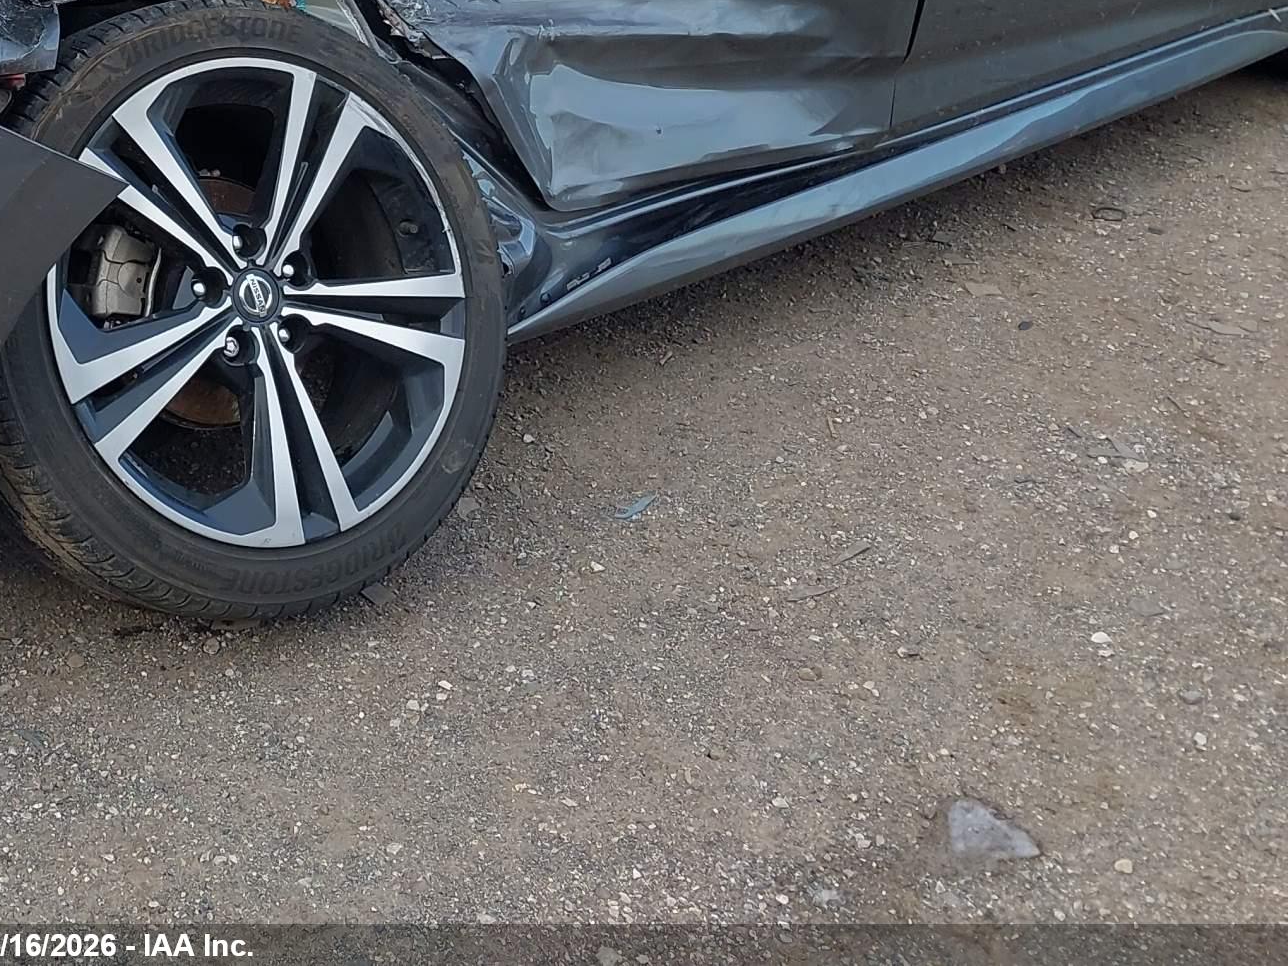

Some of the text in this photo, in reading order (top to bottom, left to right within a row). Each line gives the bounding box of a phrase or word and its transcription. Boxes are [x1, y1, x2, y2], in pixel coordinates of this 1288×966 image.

[121, 15, 302, 67] BRIDGESTONE
[248, 276, 266, 315] NISSAN
[223, 524, 406, 593] BRIDGESTONE
